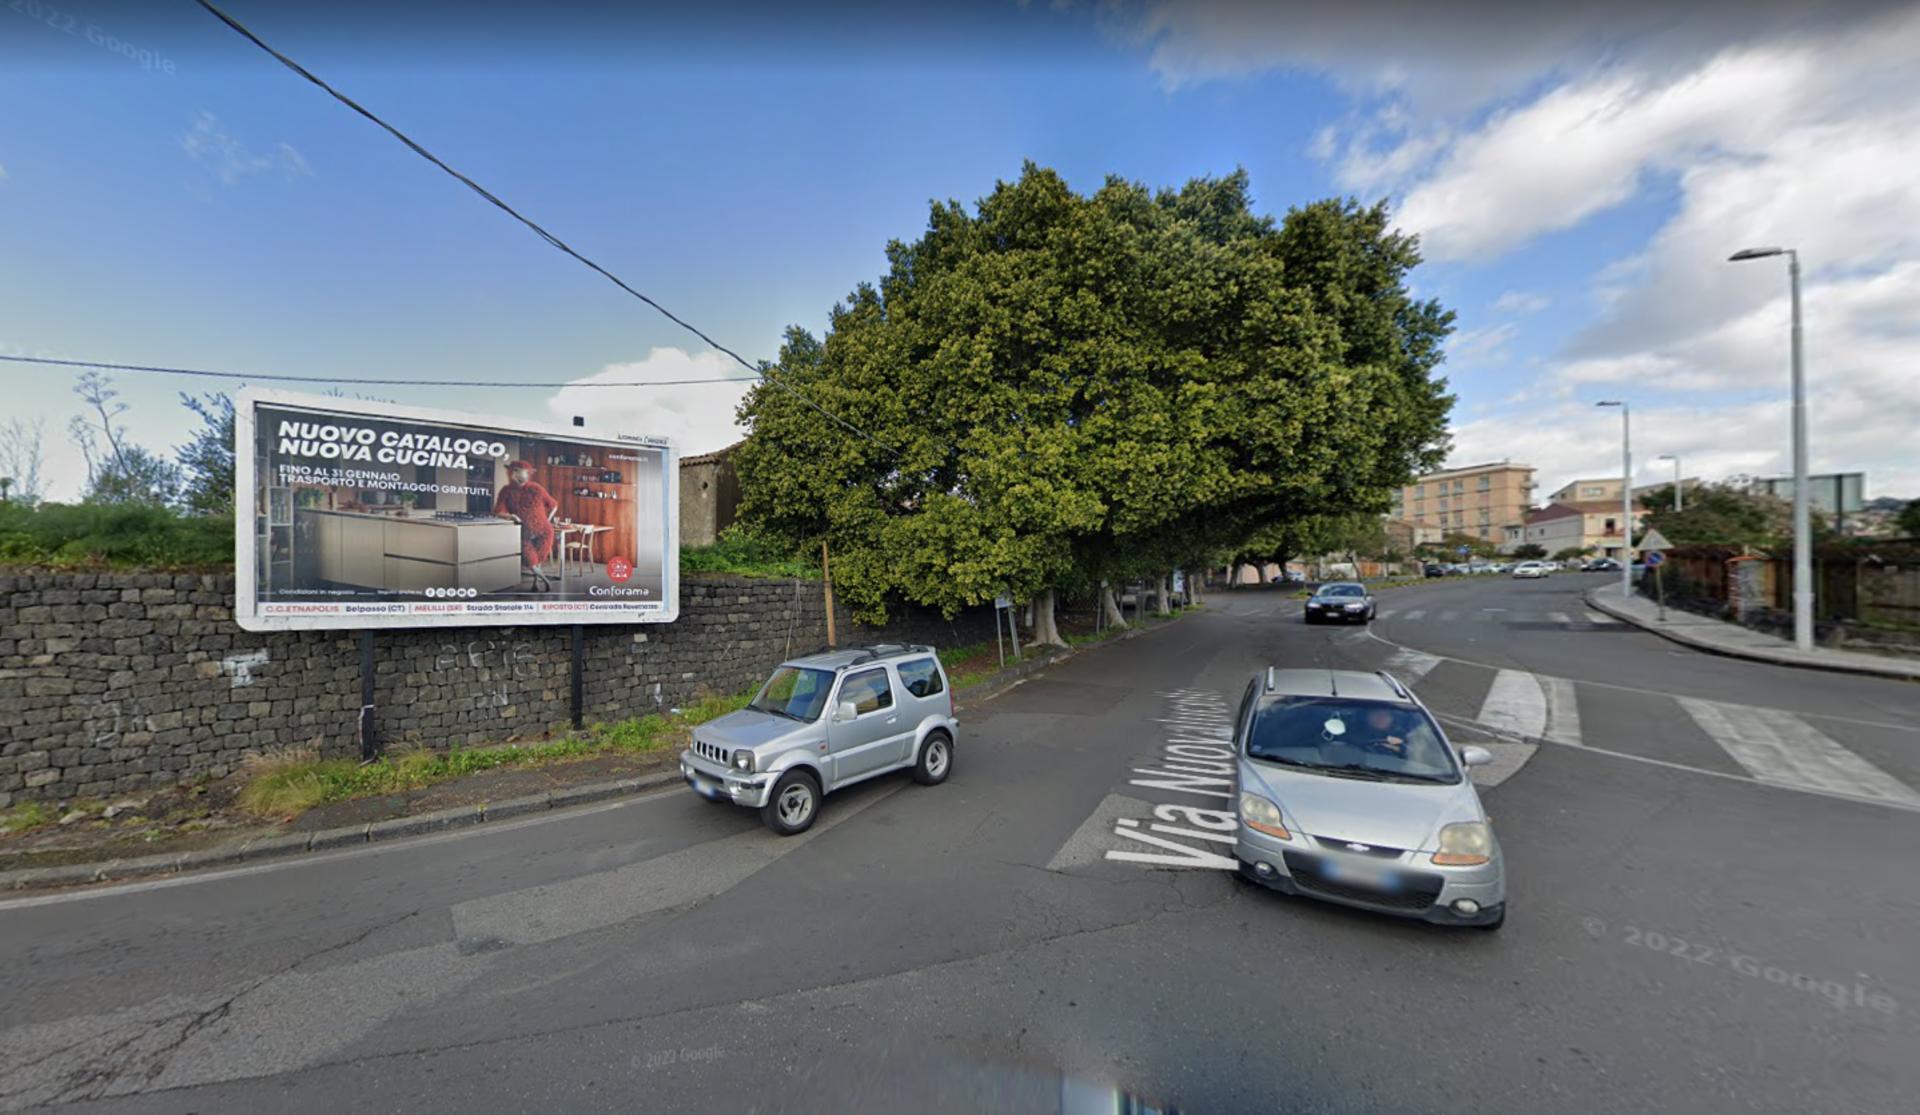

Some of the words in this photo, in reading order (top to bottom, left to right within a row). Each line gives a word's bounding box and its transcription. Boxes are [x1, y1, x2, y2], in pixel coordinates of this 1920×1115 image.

[279, 420, 376, 445] NUOVO
[381, 431, 510, 461] CATALOGO,
[279, 438, 372, 461] NUOVA
[377, 447, 474, 470] CUCINA.
[280, 464, 311, 475] FINO
[314, 467, 329, 476] AL
[332, 468, 343, 477] 31
[345, 469, 400, 482] GENNAIO
[280, 473, 355, 487] TRASPORTO
[358, 479, 365, 488] E
[367, 480, 439, 493] MONTAGGIO
[441, 484, 492, 497] GRATUITI.
[589, 585, 650, 597] Conforama
[346, 604, 386, 613] Belpasso
[388, 604, 405, 613] (CT)
